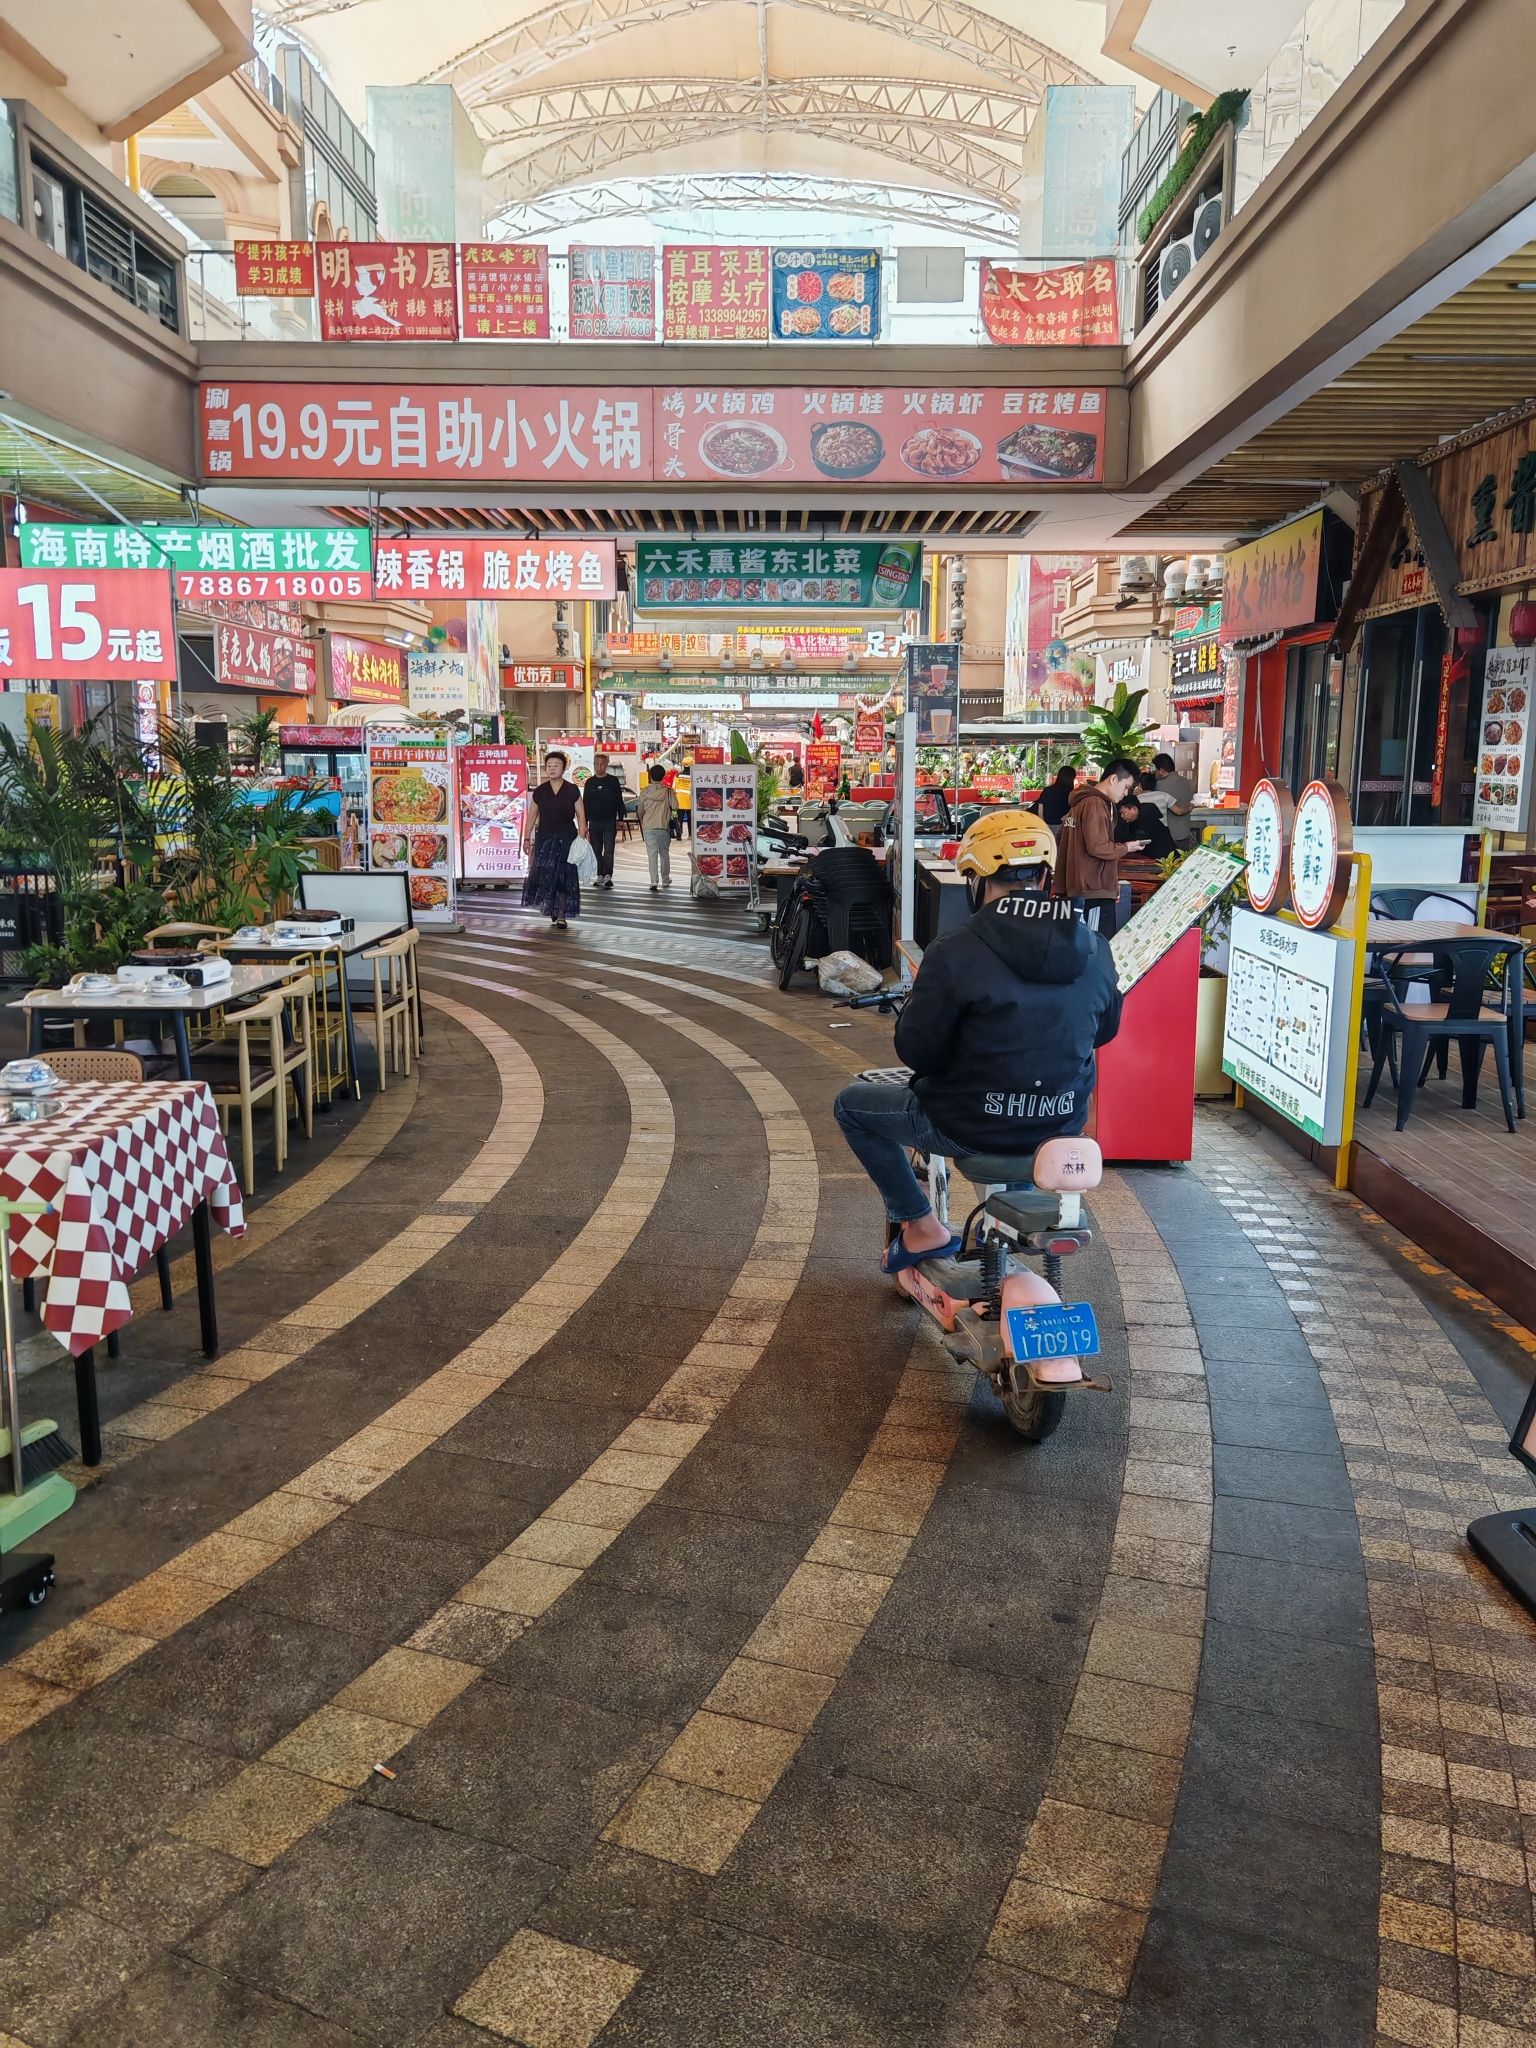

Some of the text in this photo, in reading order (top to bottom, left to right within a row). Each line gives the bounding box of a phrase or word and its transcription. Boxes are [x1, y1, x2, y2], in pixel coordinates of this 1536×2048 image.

[247, 243, 302, 262] 提升孩子
[719, 249, 766, 278] 采耳
[247, 266, 303, 285] 学习成绩
[1005, 263, 1113, 302] 太公取名
[666, 279, 766, 306] 按摩 头疗
[323, 298, 344, 318] 读书
[475, 319, 538, 335] 请上二楼
[666, 325, 769, 340] 6号楼请上二楼248
[693, 392, 1101, 416] 火锅鸡 火锅蛙 火锅虾 豆花烤鱼
[232, 396, 642, 470] 19.9元自助小火锅
[29, 526, 363, 571] 海南特产烟酒批发
[643, 548, 862, 575] 六禾熏酱东北菜
[375, 548, 605, 591] 辣香锅 脆皮烤鱼
[877, 565, 911, 583] TSINGTAO
[371, 748, 447, 761] 工作日午市特惠
[984, 1091, 1075, 1117] SHING
[1021, 1328, 1092, 1358] 170919
